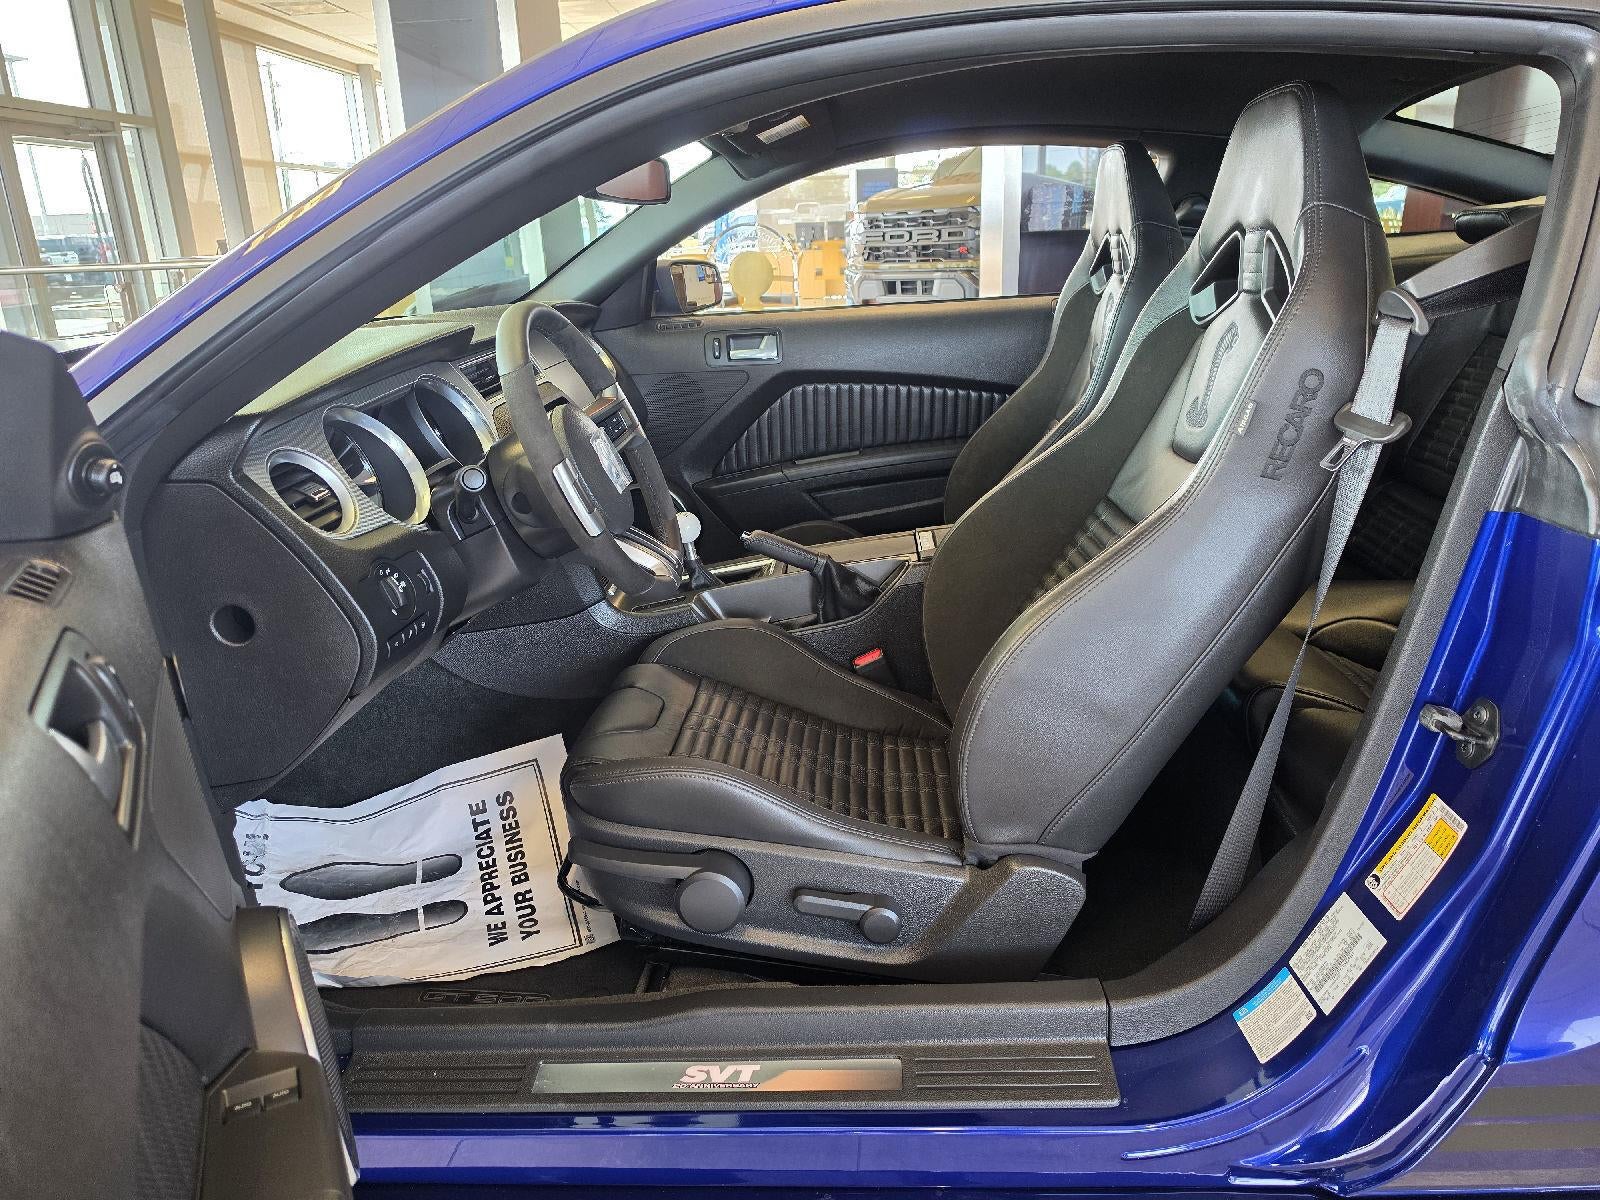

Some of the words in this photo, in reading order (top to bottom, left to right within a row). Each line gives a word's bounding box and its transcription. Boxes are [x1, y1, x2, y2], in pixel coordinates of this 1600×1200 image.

[860, 227, 967, 244] FORD
[1260, 367, 1325, 482] RECARO
[468, 799, 505, 916] APPRECIATE
[496, 790, 530, 886] BUSINESS
[486, 921, 509, 947] WE
[514, 888, 541, 941] YOUR
[679, 1064, 761, 1083] SVT
